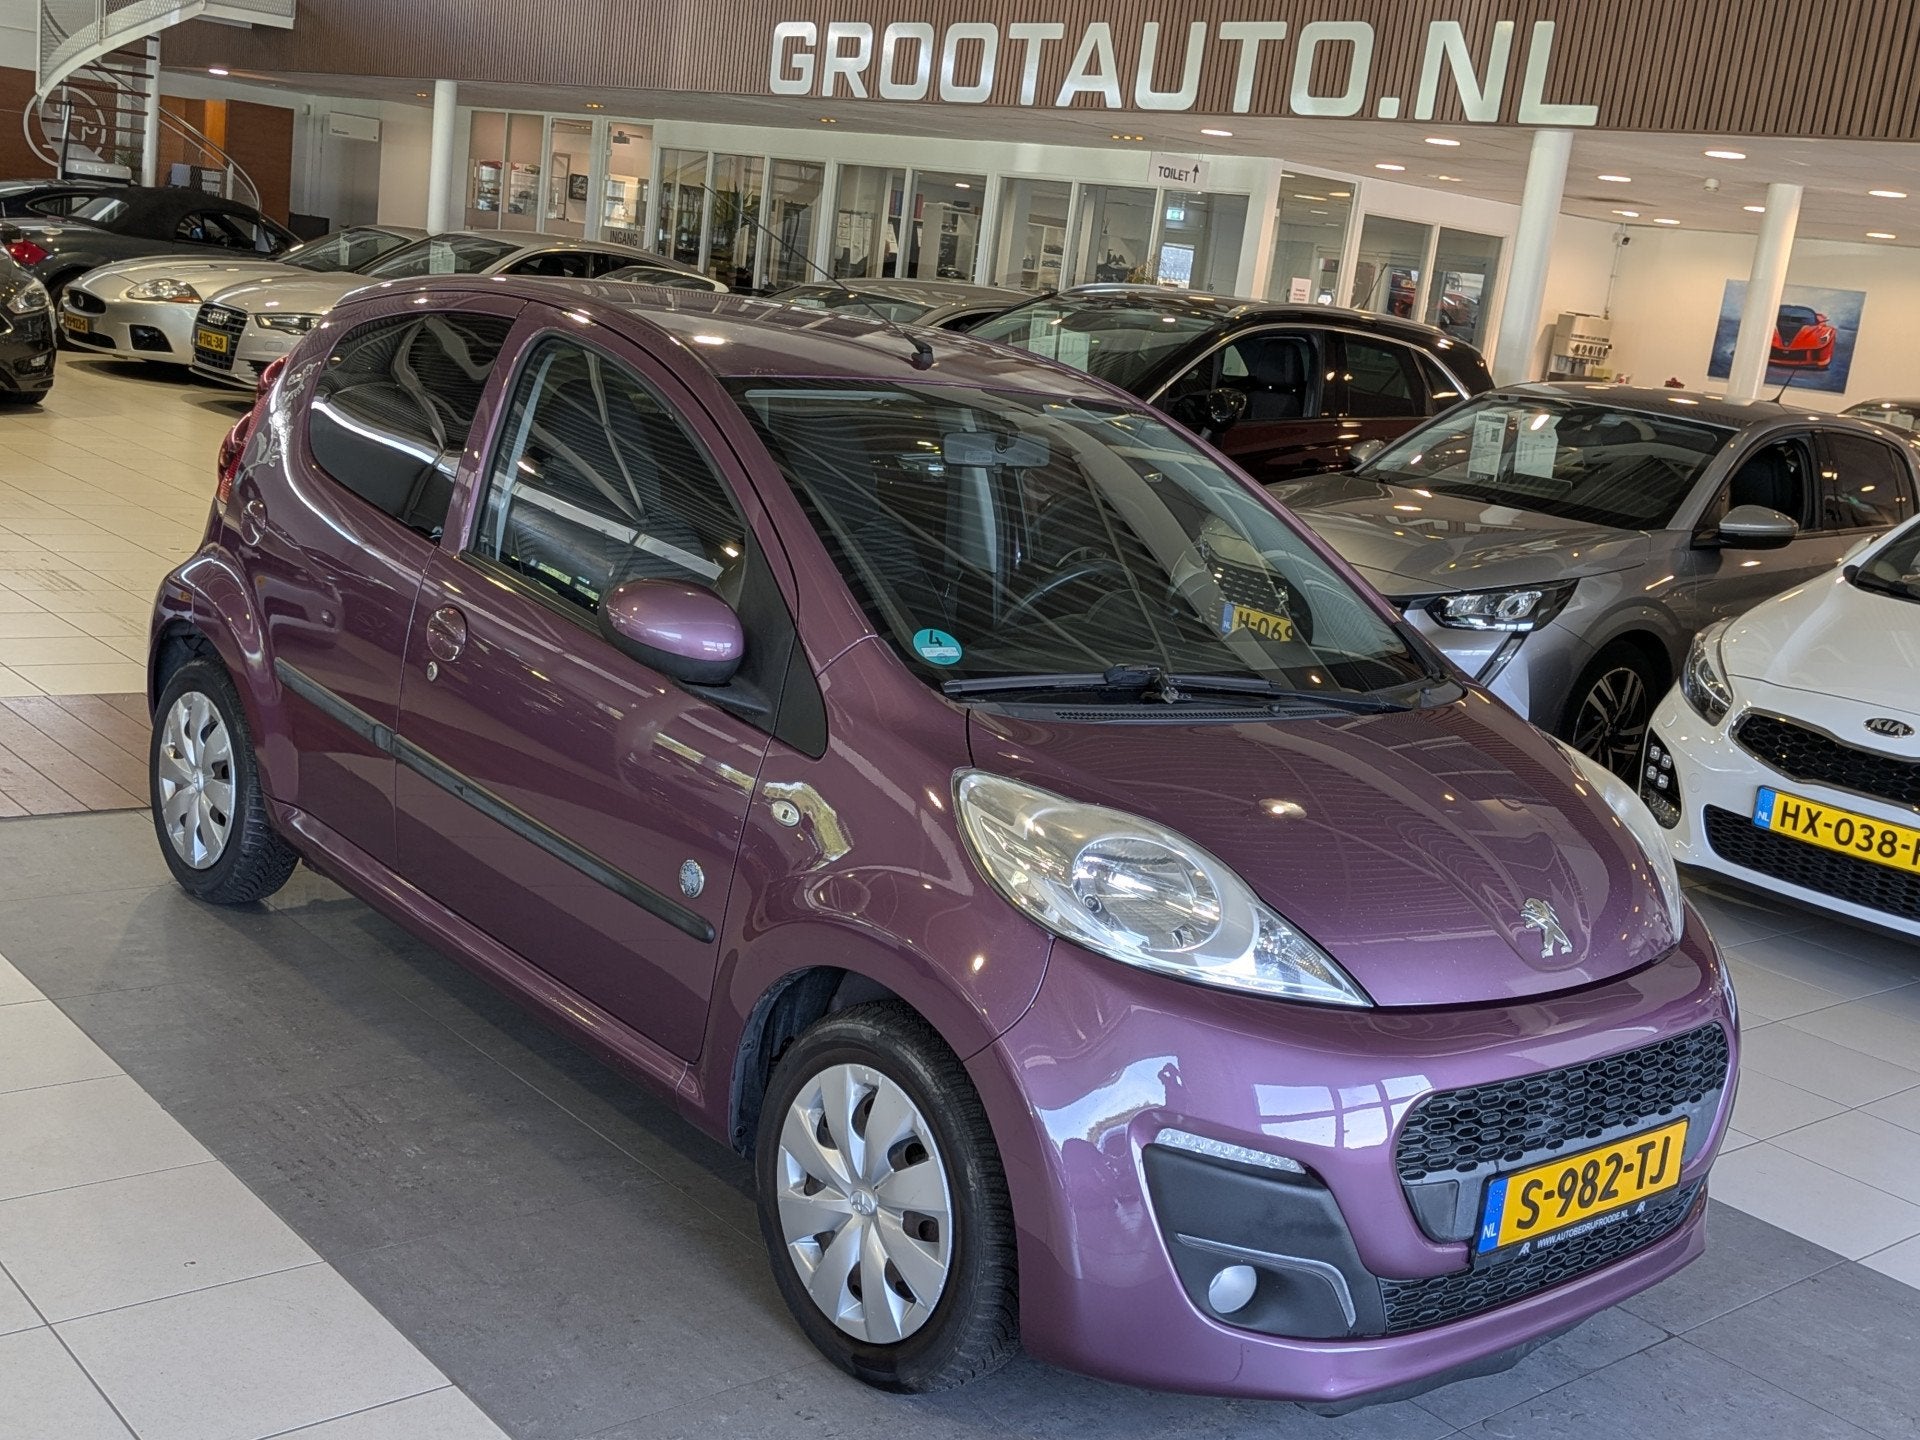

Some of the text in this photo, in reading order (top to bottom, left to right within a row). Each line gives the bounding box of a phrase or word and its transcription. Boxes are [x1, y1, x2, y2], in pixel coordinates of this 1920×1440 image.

[769, 20, 1599, 127] GROOTAUTO.NL
[1158, 165, 1190, 182] TOILET
[610, 229, 638, 247] INGANG
[928, 629, 943, 647] 4
[1870, 718, 1907, 736] KIA
[1756, 810, 1770, 822] NL
[1516, 1135, 1671, 1230] S-982-TJ
[1482, 1224, 1497, 1240] NL
